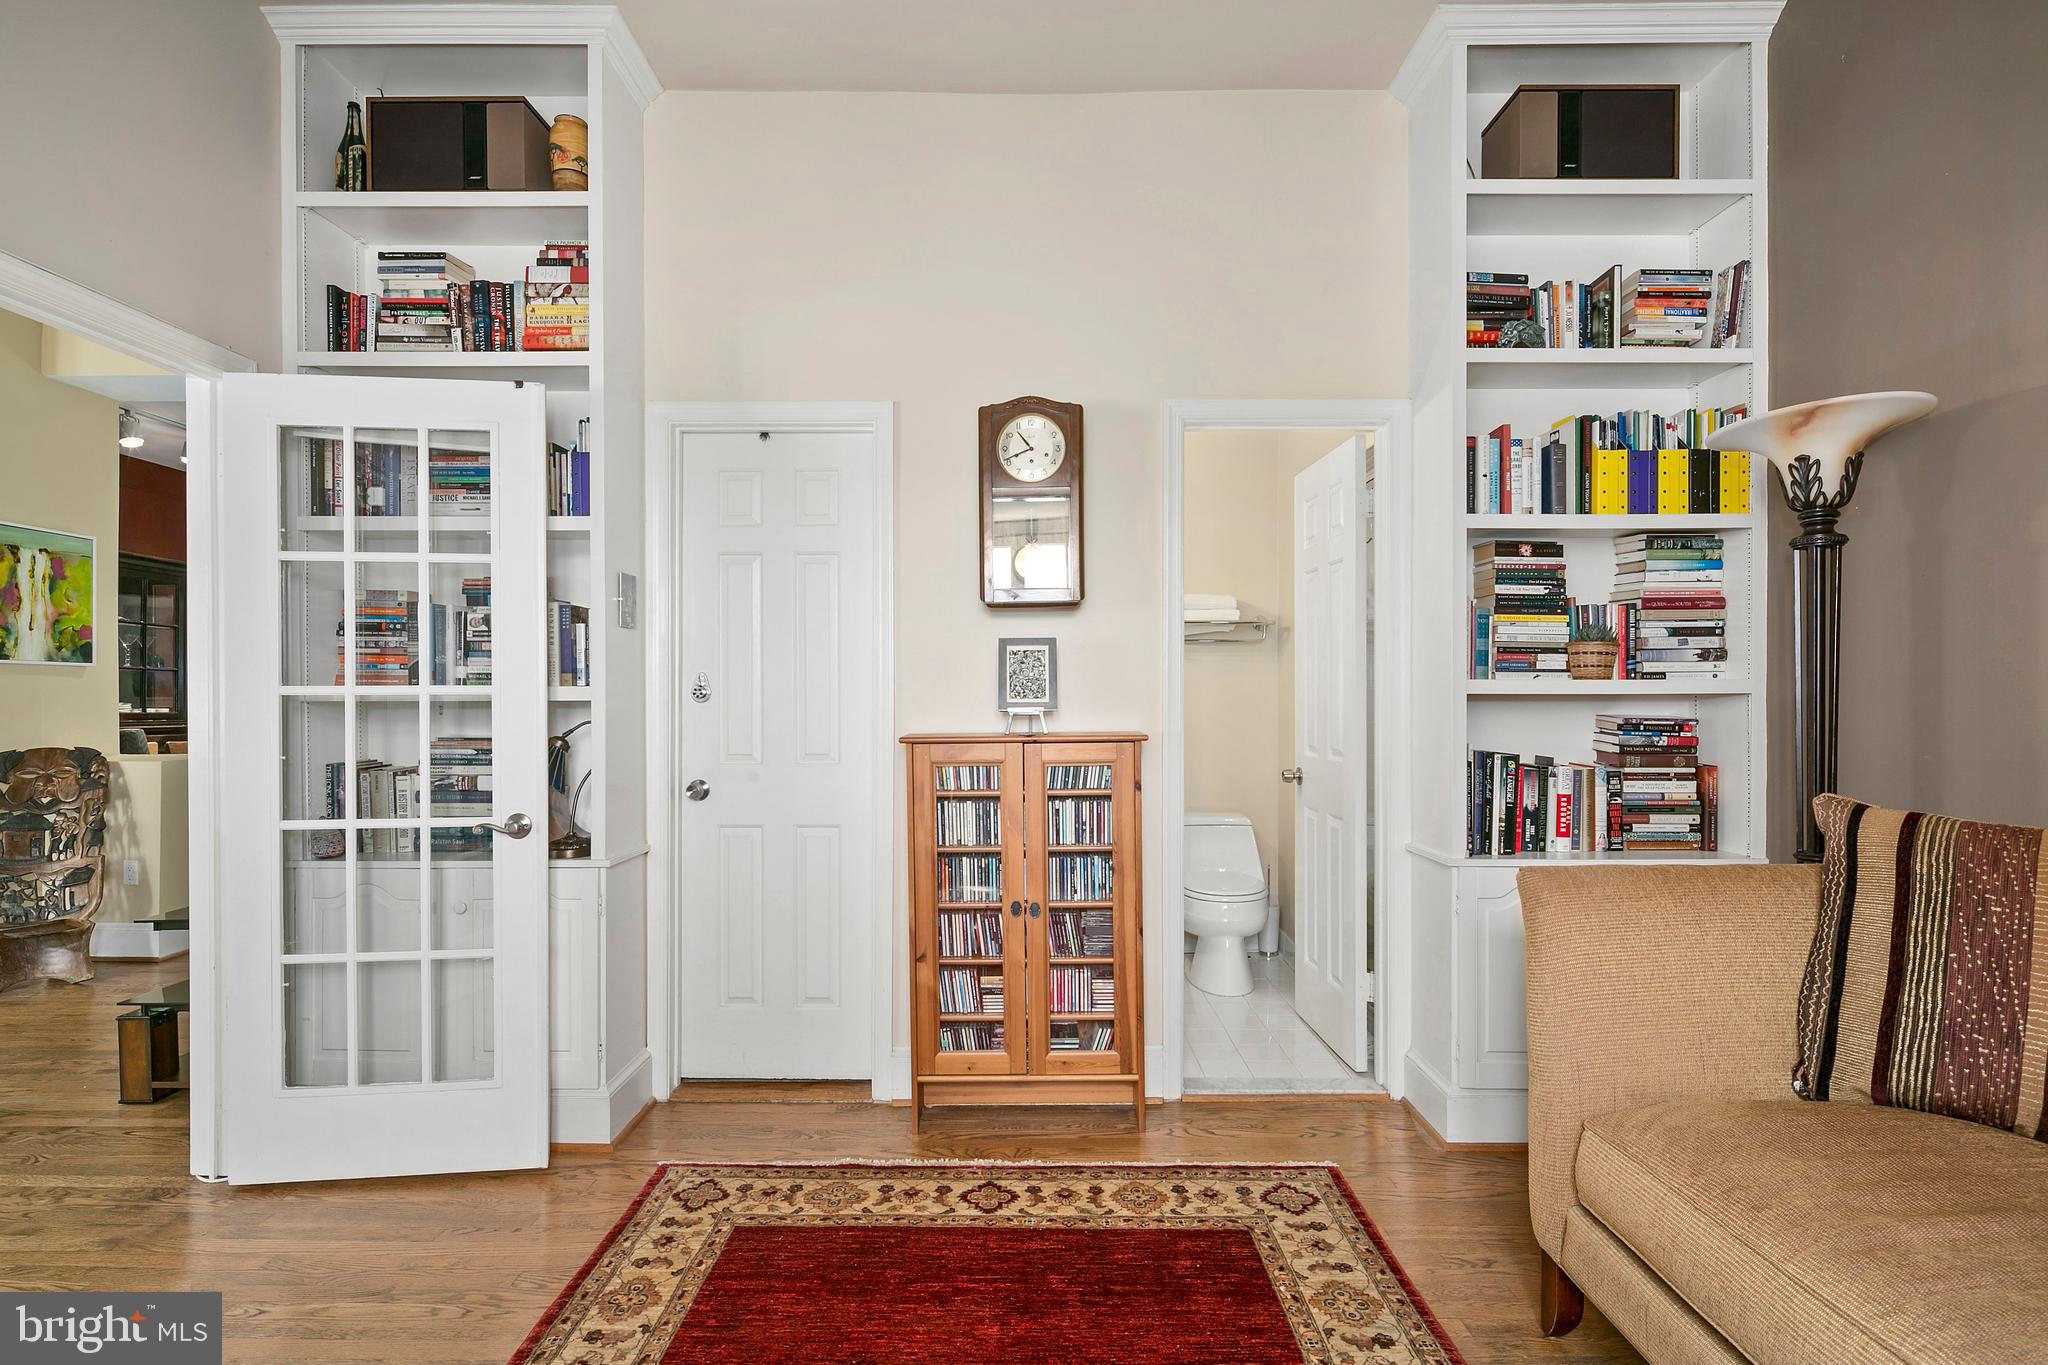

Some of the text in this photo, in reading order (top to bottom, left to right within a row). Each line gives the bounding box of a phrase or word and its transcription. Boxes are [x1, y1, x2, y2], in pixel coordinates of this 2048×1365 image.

[1055, 444, 1061, 452] 3
[407, 458, 416, 505] ISRAEL
[432, 494, 460, 502] JUSTICE
[1506, 776, 1514, 803] LANGUAGE
[398, 794, 408, 813] HISTORY
